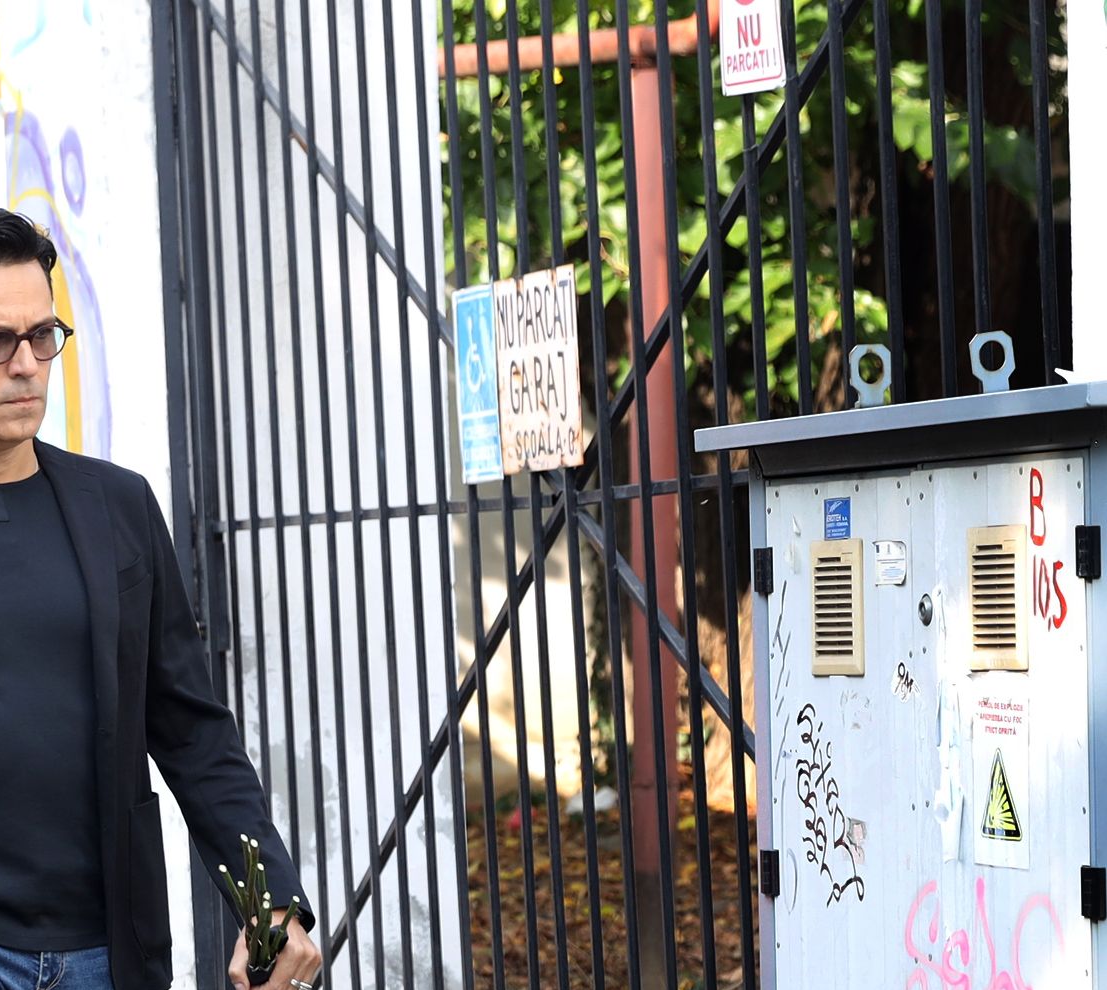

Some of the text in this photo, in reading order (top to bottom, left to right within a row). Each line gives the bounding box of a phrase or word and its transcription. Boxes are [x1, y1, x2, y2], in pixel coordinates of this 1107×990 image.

[737, 13, 761, 49] NU
[496, 293, 515, 351] NU
[509, 351, 568, 422] GARAJ
[1029, 467, 1047, 546] B
